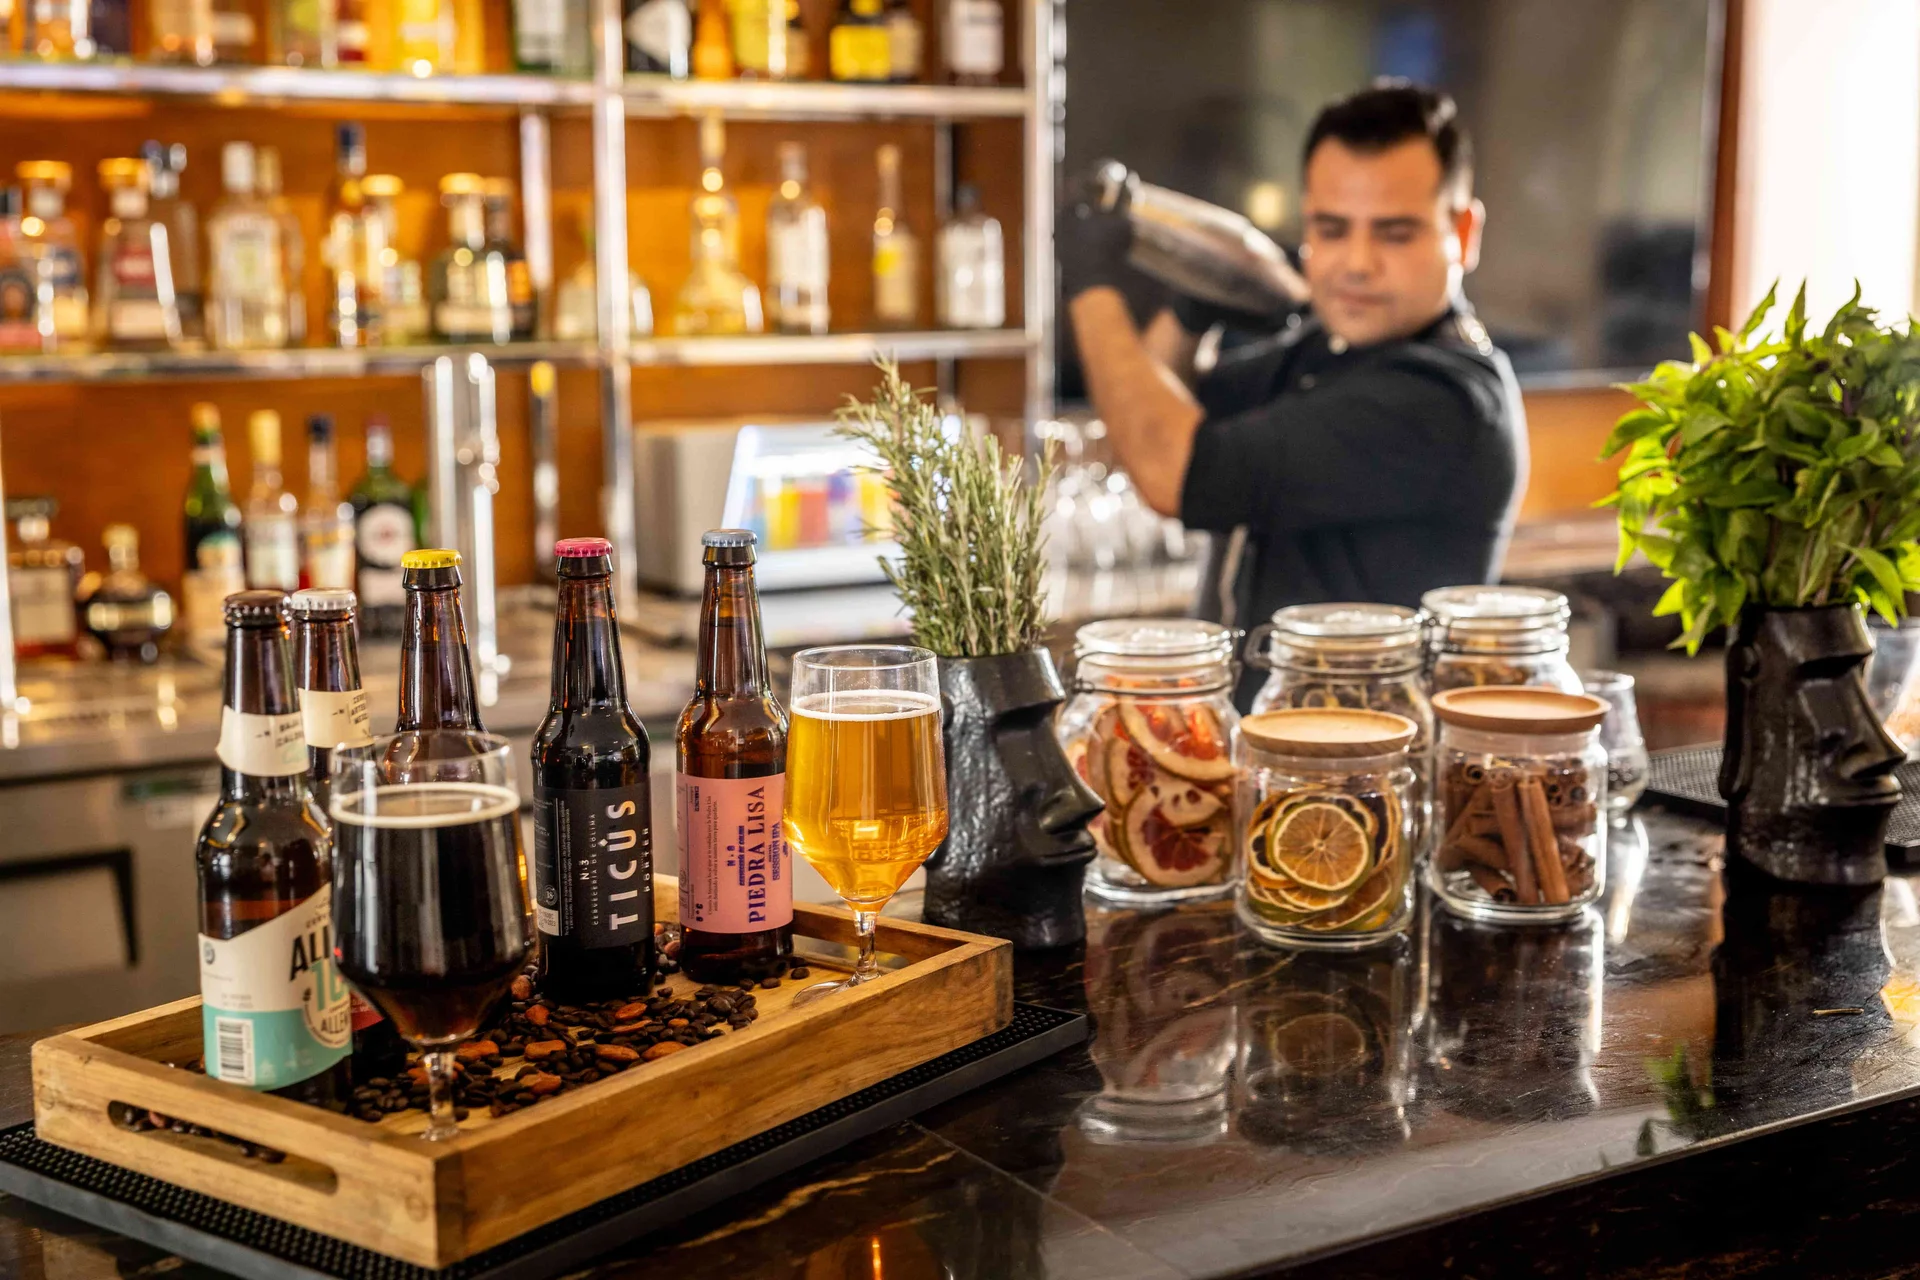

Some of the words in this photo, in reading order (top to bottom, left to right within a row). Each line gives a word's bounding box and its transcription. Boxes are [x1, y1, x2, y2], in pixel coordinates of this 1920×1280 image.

[747, 786, 765, 835] LISA
[771, 822, 780, 839] IPA
[591, 853, 598, 864] DE
[772, 840, 780, 881] SESSION
[747, 842, 766, 923] PIEDRA
